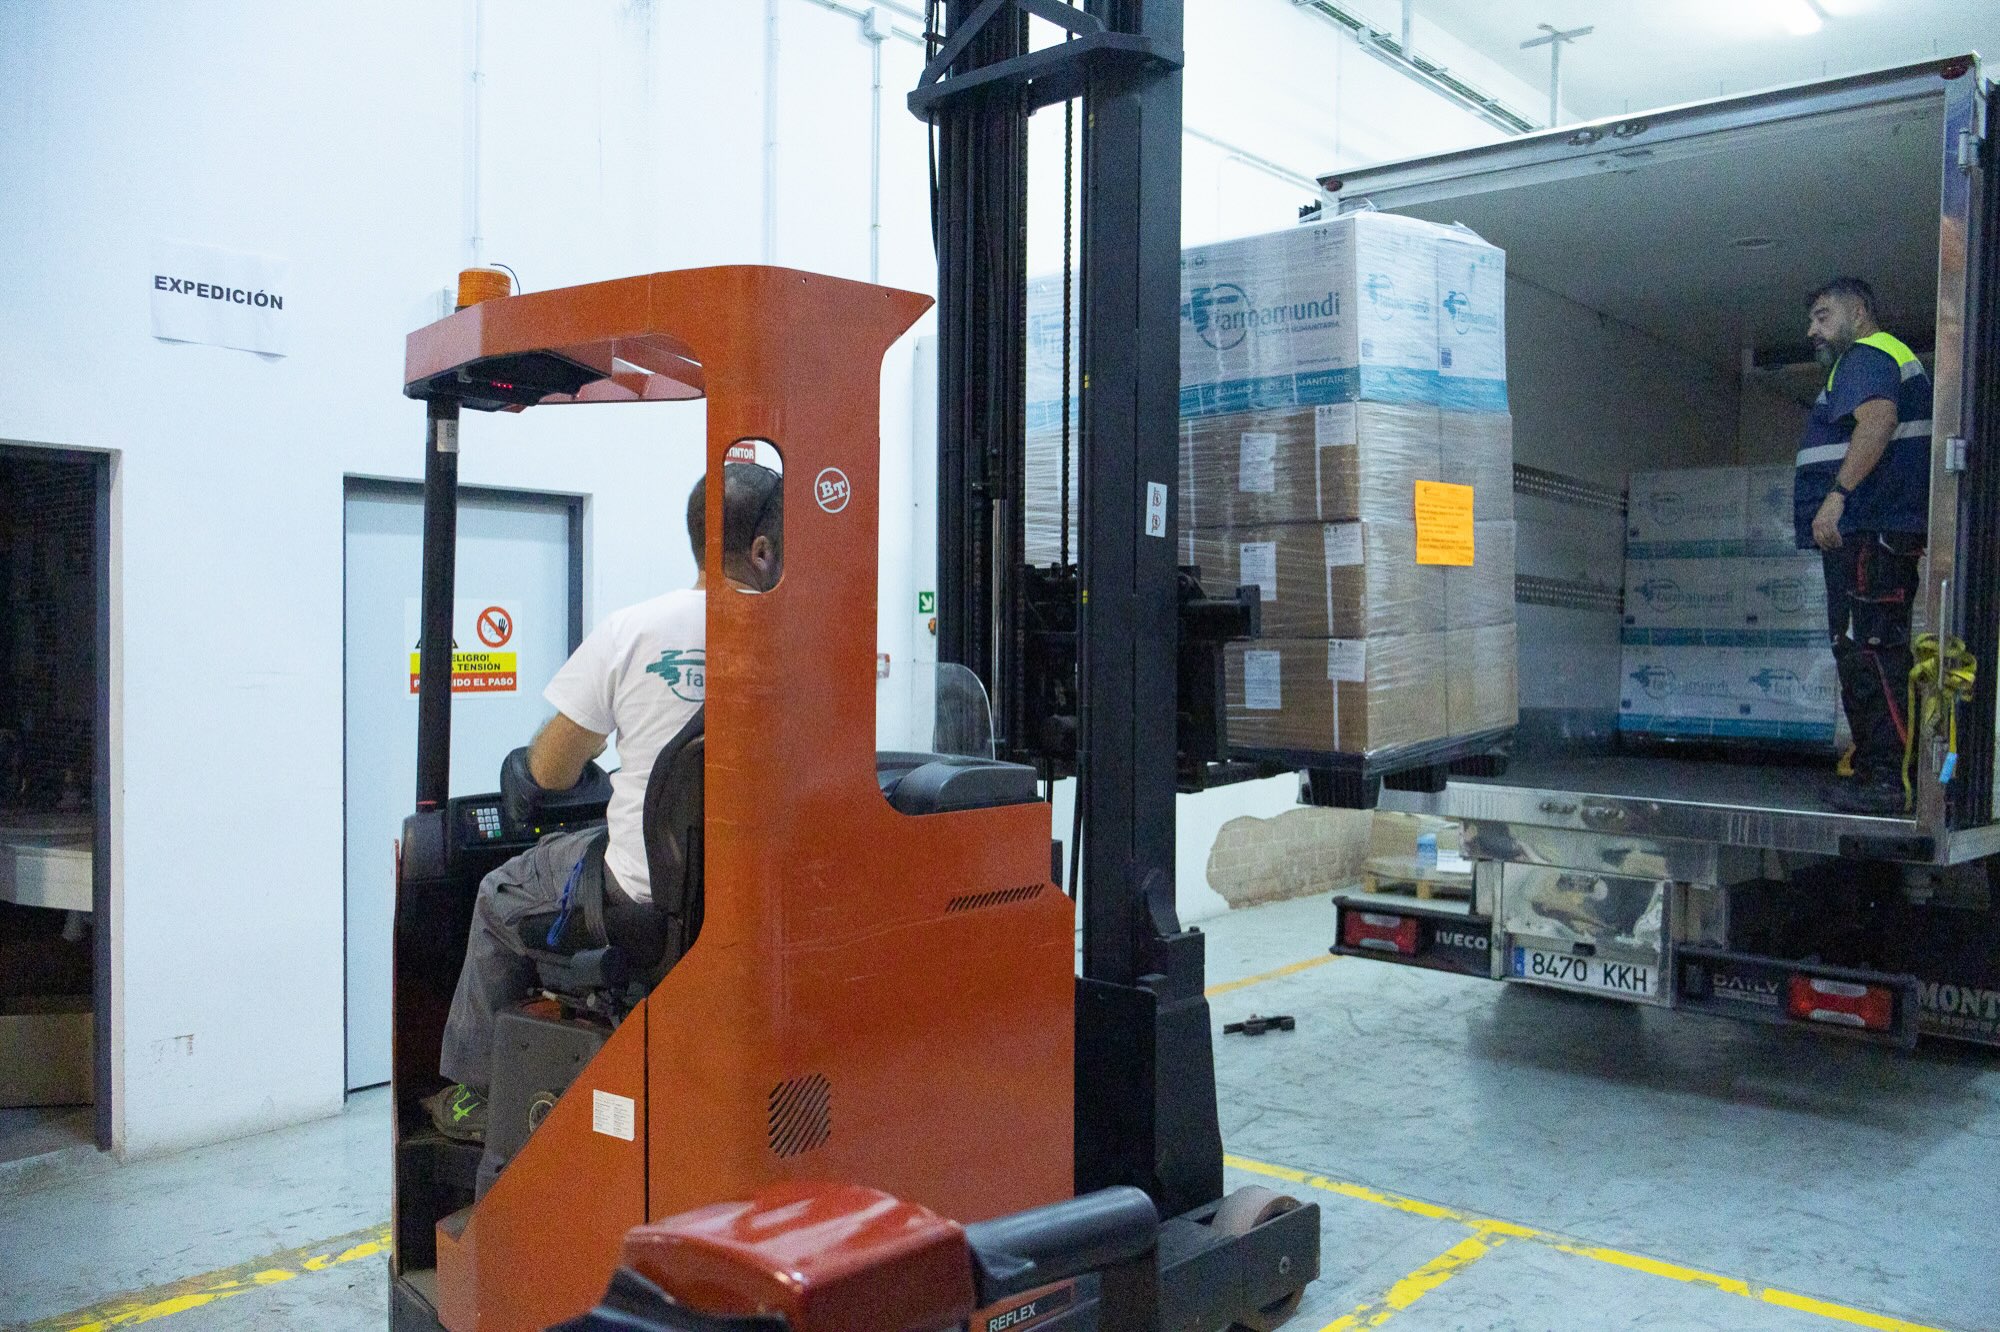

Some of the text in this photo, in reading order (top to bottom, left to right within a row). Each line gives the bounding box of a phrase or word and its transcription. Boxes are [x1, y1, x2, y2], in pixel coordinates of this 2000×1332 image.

[154, 274, 283, 310] EXPEDICIÓN
[451, 653, 490, 662] ELIGRO!
[458, 662, 501, 671] TENSIÓN
[473, 677, 486, 687] EL
[488, 677, 514, 687] PASO
[686, 667, 704, 688] fa
[1435, 930, 1488, 950] IVECO
[1532, 952, 1647, 993] 8470 KKH
[989, 1302, 1036, 1332] REFLEX
